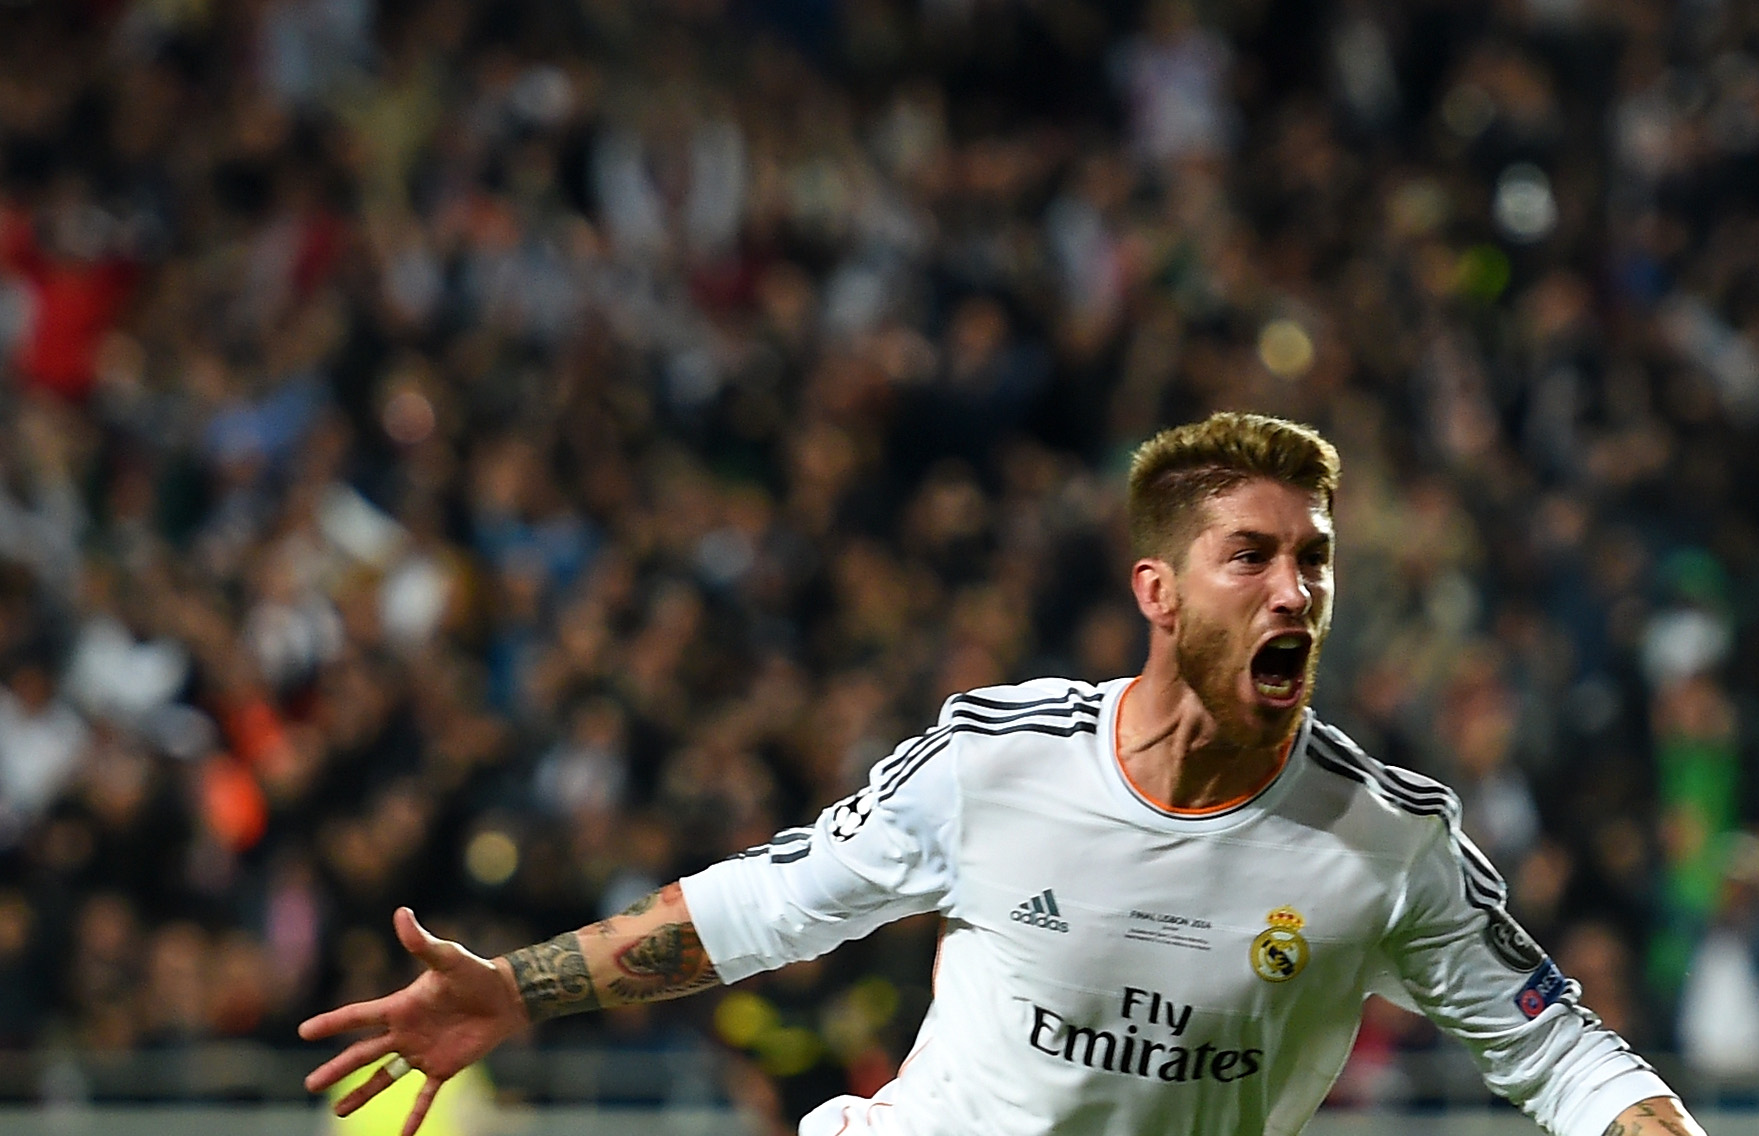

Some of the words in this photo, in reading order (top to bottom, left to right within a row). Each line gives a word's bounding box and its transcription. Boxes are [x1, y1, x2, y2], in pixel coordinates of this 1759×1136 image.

[1010, 908, 1069, 933] adidas
[1120, 986, 1193, 1036] Fly
[1028, 1004, 1264, 1083] Emirates
